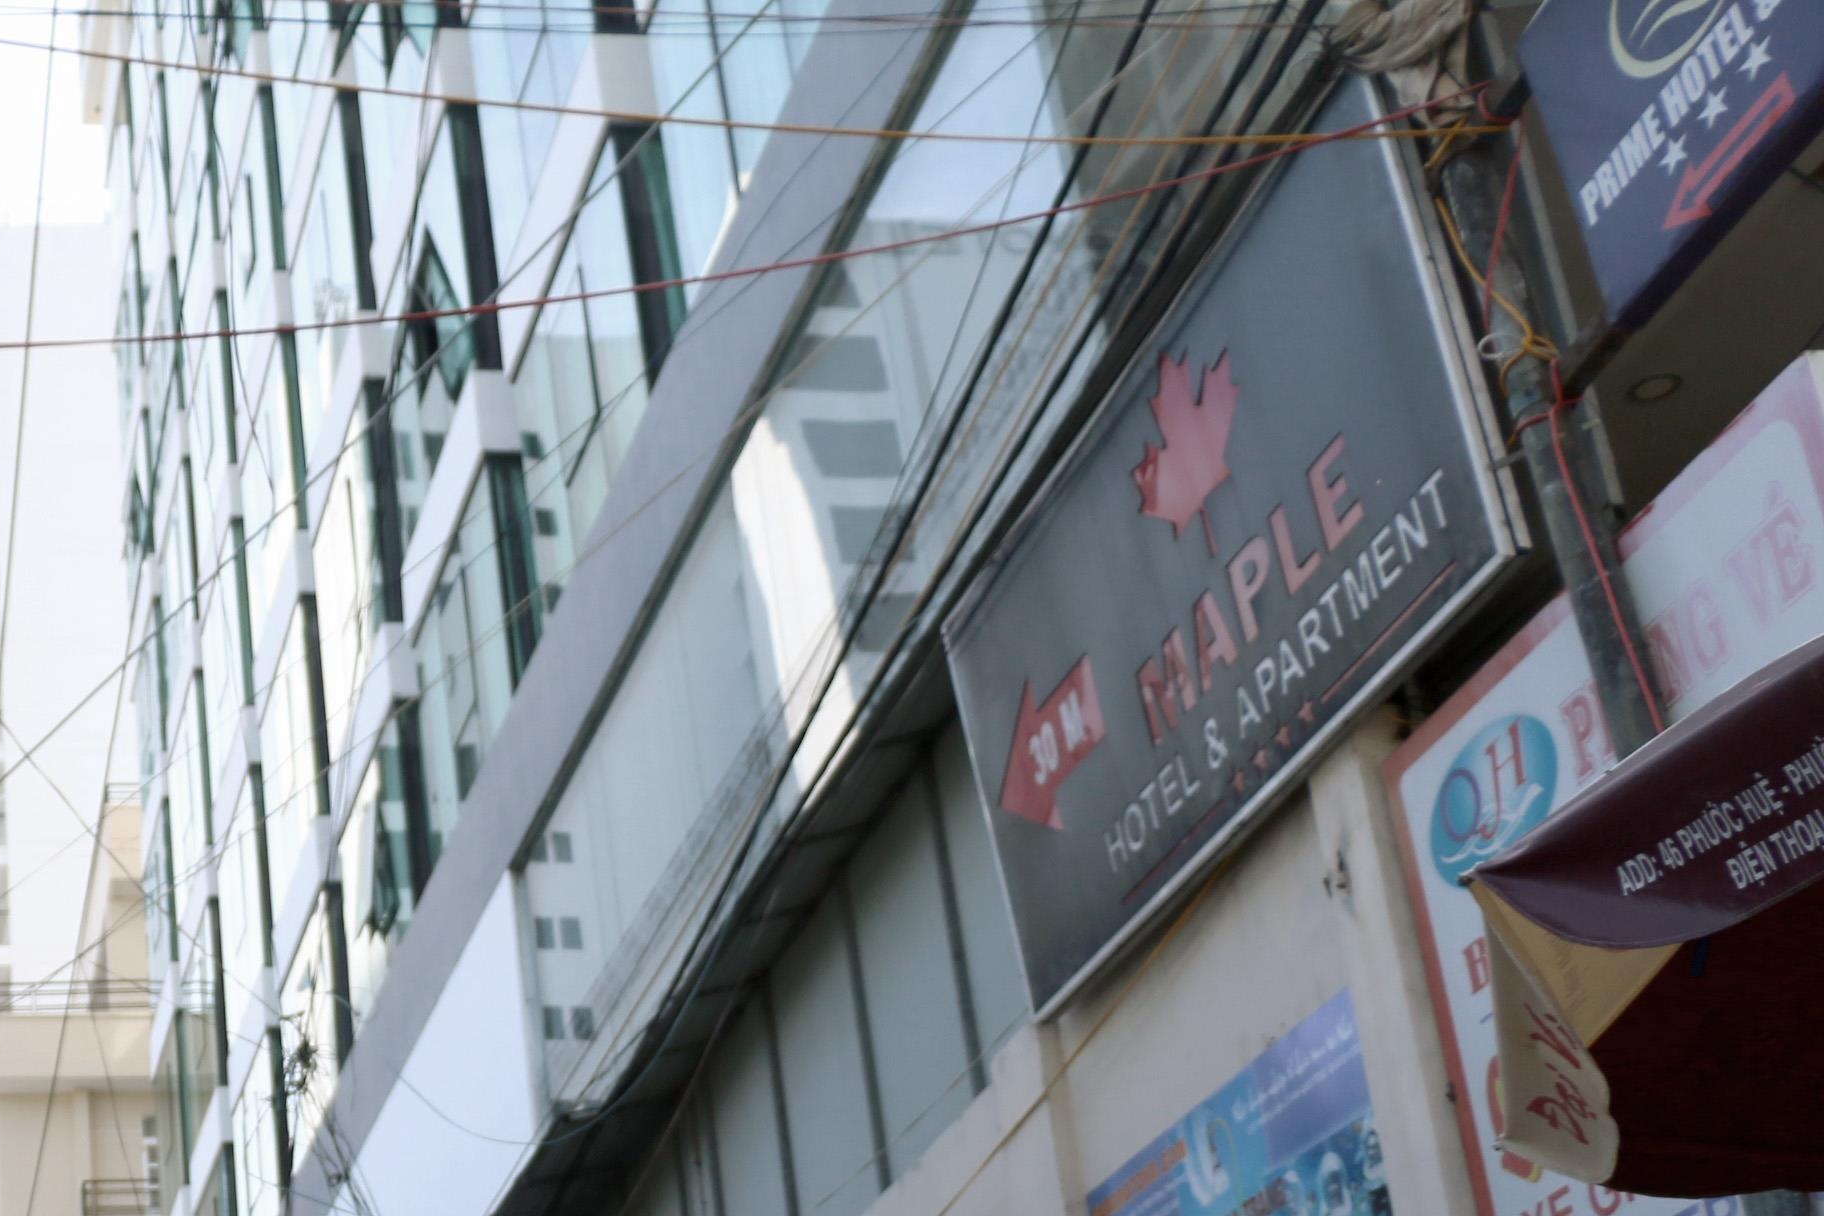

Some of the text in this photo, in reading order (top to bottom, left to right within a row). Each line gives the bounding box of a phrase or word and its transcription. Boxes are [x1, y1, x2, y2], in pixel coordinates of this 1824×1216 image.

[1578, 3, 1755, 228] PRIME HOTEL
[1136, 431, 1366, 747] MAPLE
[1104, 468, 1448, 872] HOTEL & APARTMENT
[1029, 720, 1060, 786] 30
[1616, 852, 1664, 896] ADD:
[1656, 837, 1686, 870] 46
[1725, 841, 1777, 890] ĐIỆN
